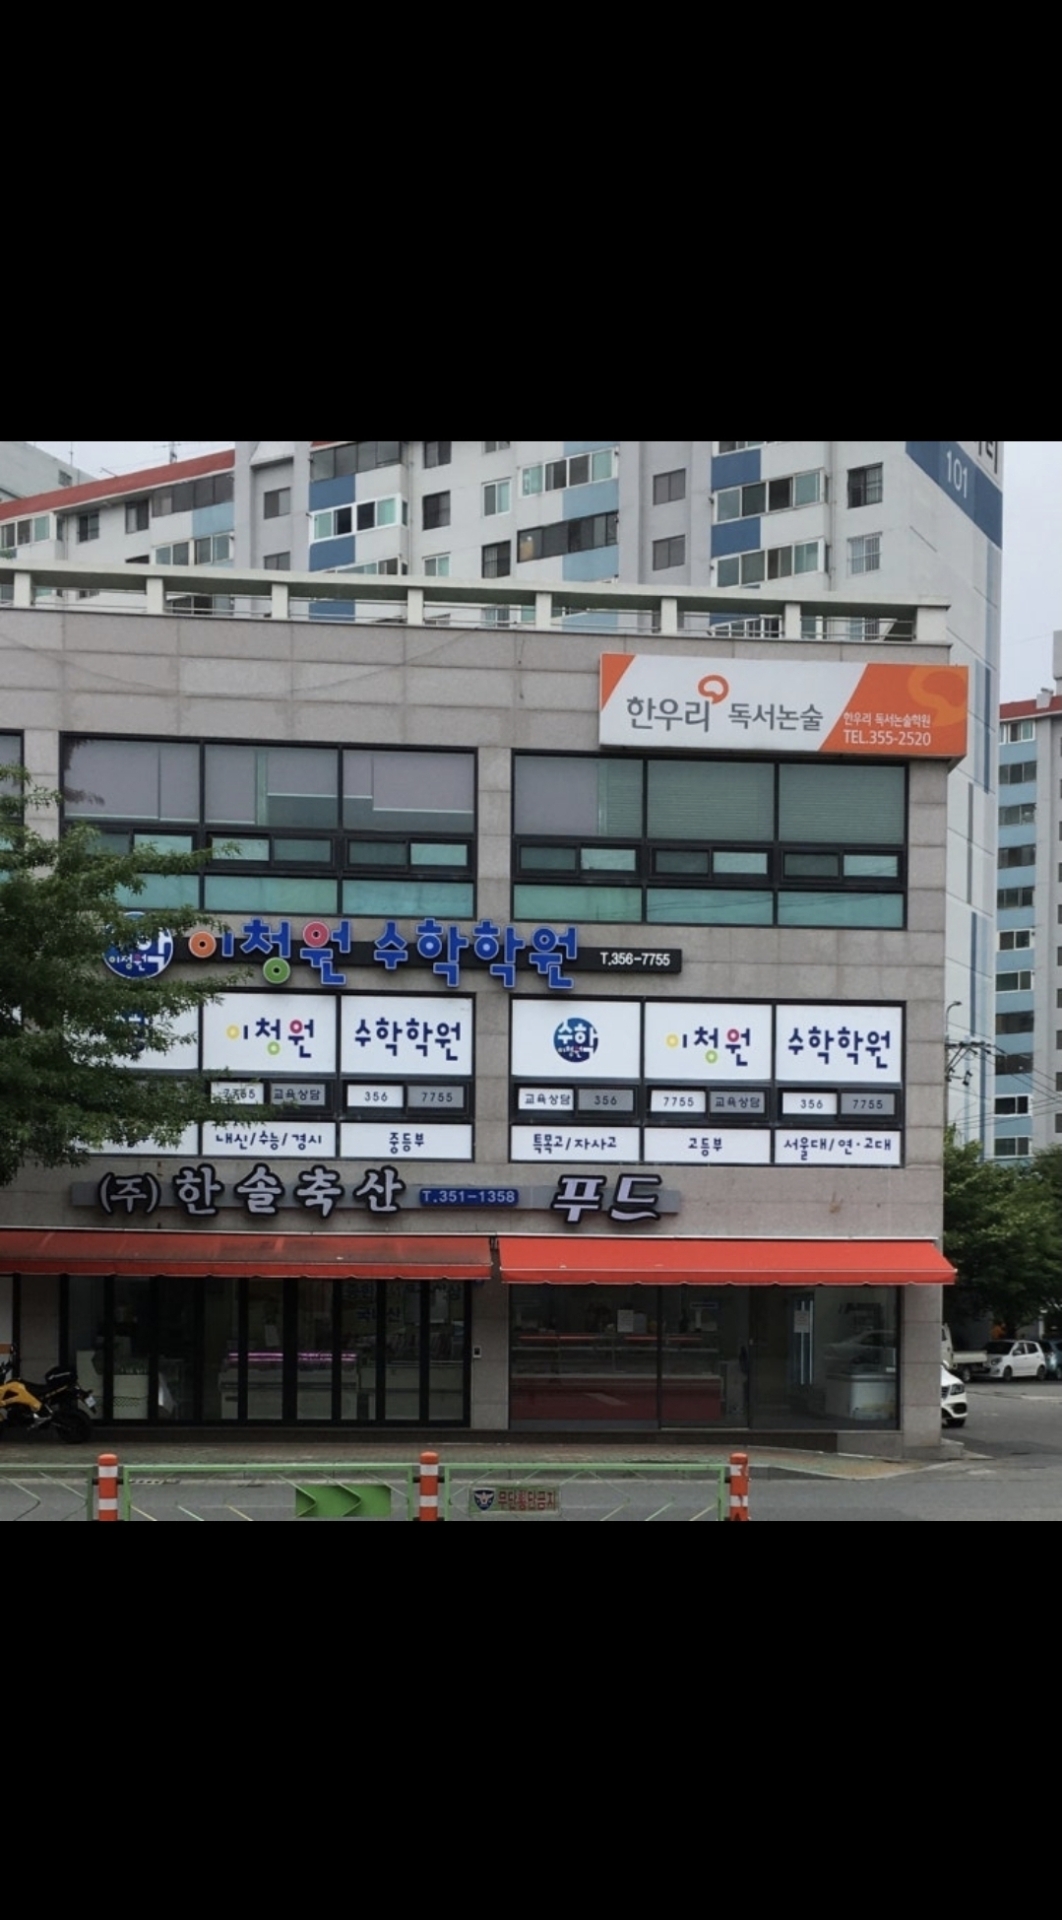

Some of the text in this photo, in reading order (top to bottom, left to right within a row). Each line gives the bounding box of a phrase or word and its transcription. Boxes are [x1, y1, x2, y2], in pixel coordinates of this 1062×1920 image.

[946, 450, 968, 499] 101
[626, 696, 824, 732] 한우리 독서논술
[843, 712, 931, 729] 한우리 독서논술학원
[843, 729, 932, 747] TEL.355-2520
[188, 917, 671, 989] 이청원 수학학원 T.356-7755
[226, 1017, 315, 1059] 이청원
[355, 1017, 461, 1062] 수학학원
[666, 1026, 751, 1067] 이청원
[788, 1026, 891, 1069] 수학학원
[273, 1087, 321, 1102] 교육상담
[364, 1091, 388, 1103] 356
[421, 1092, 453, 1103] 7755
[524, 1093, 571, 1106] 교육상담
[594, 1094, 618, 1106] 356
[663, 1096, 695, 1107] 7755
[715, 1096, 760, 1109] 교육상담
[800, 1098, 824, 1109] 356
[852, 1099, 883, 1110] 7755
[389, 1132, 425, 1154] 중등부
[688, 1137, 722, 1157] 고등부
[421, 1189, 516, 1204] T.351-1358
[551, 1175, 662, 1223] 푸드
